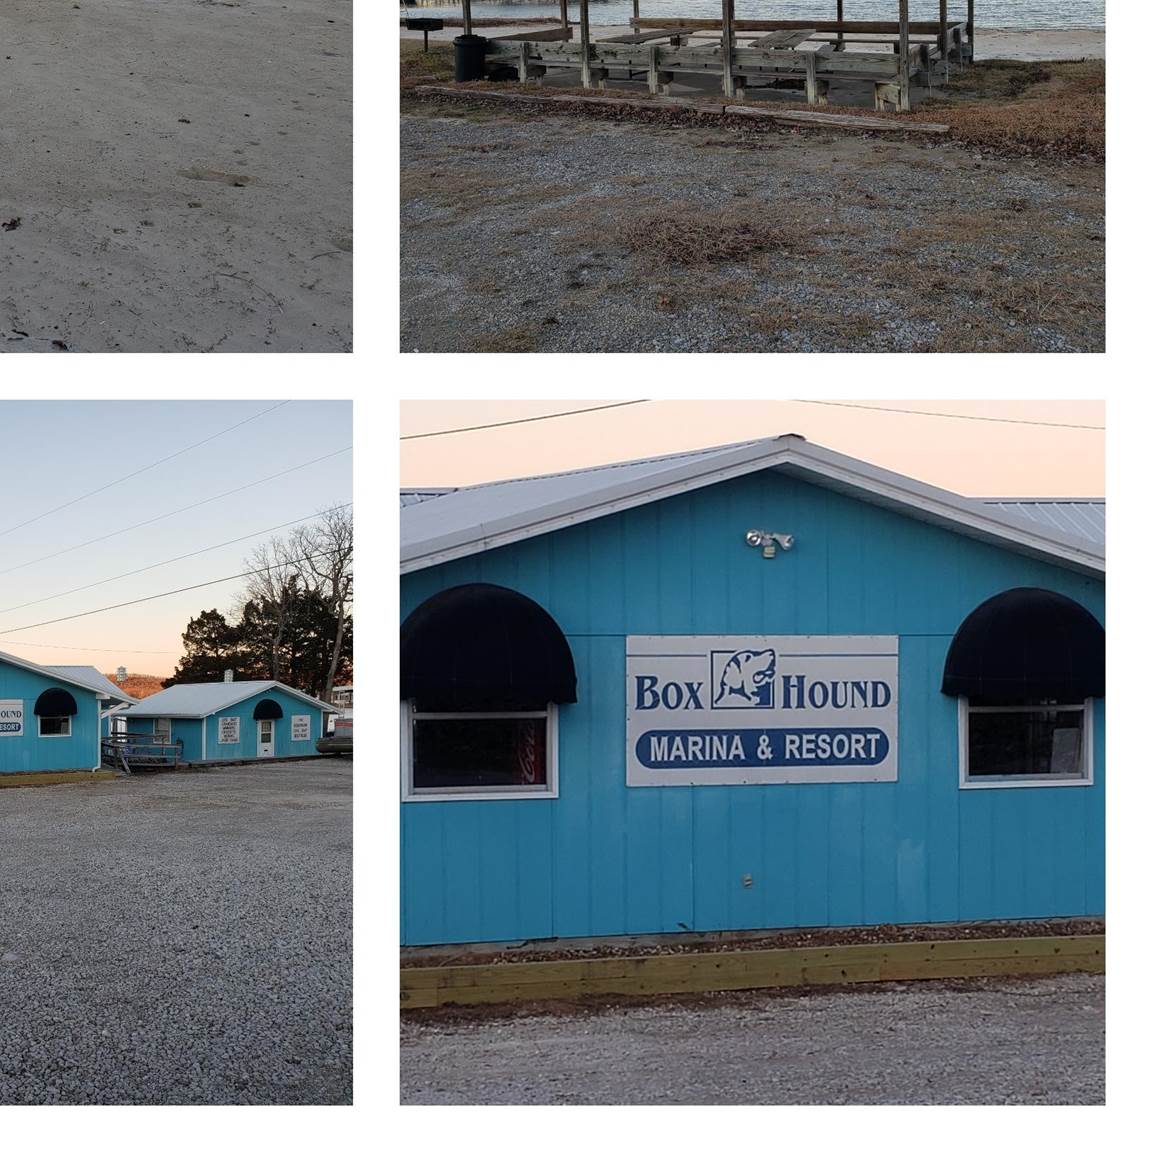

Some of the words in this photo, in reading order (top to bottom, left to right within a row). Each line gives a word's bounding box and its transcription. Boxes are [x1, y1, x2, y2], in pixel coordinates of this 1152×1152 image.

[650, 735, 746, 762] MARINA
[756, 734, 774, 760] &
[785, 733, 881, 759] RESORT
